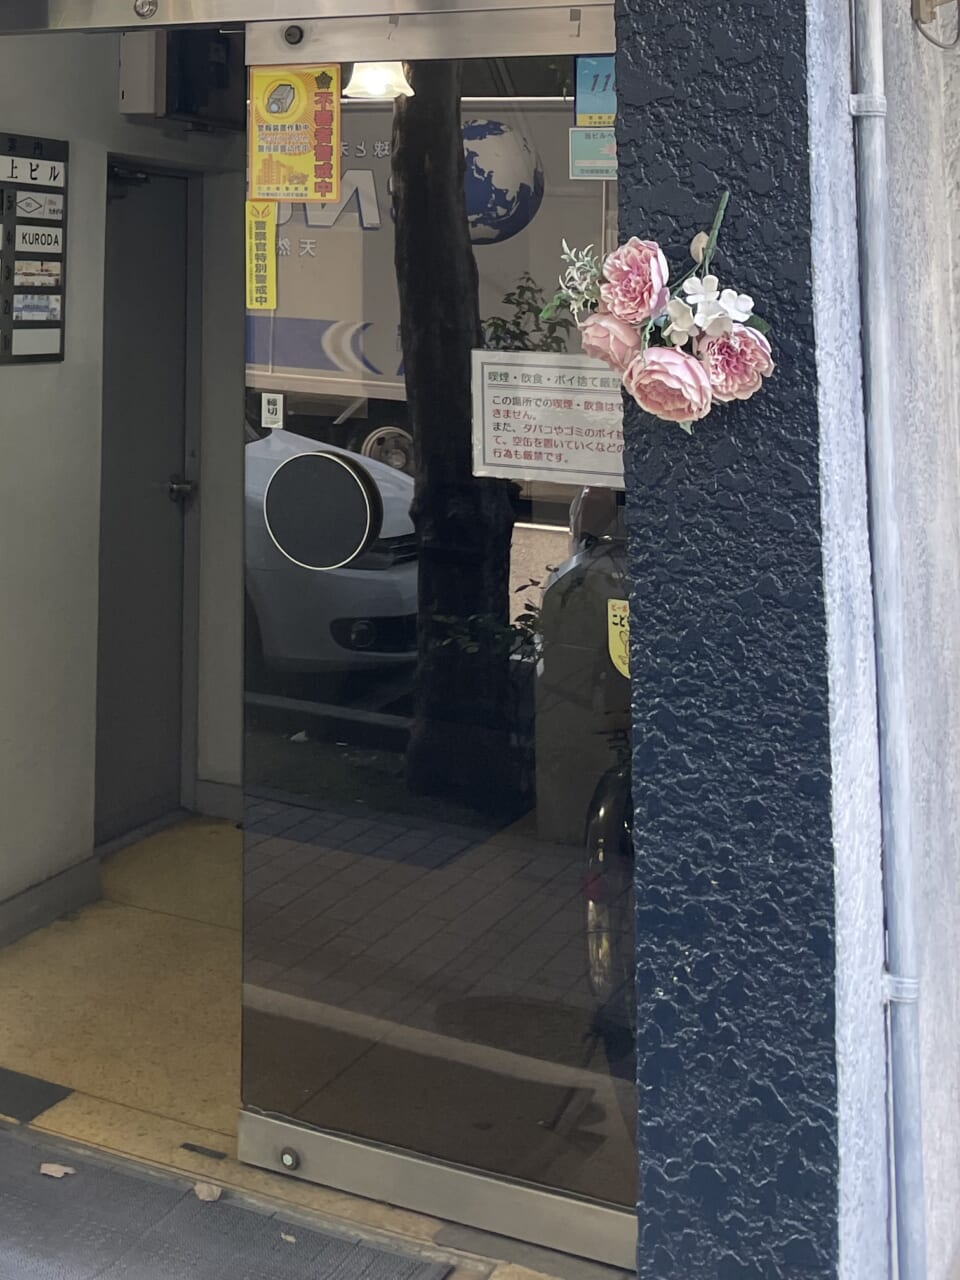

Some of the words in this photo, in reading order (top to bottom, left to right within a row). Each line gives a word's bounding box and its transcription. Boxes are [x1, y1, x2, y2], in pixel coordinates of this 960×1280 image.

[22, 232, 59, 246] KURODA
[492, 408, 537, 421] きません。
[493, 448, 569, 463] 行為も厳禁です。
